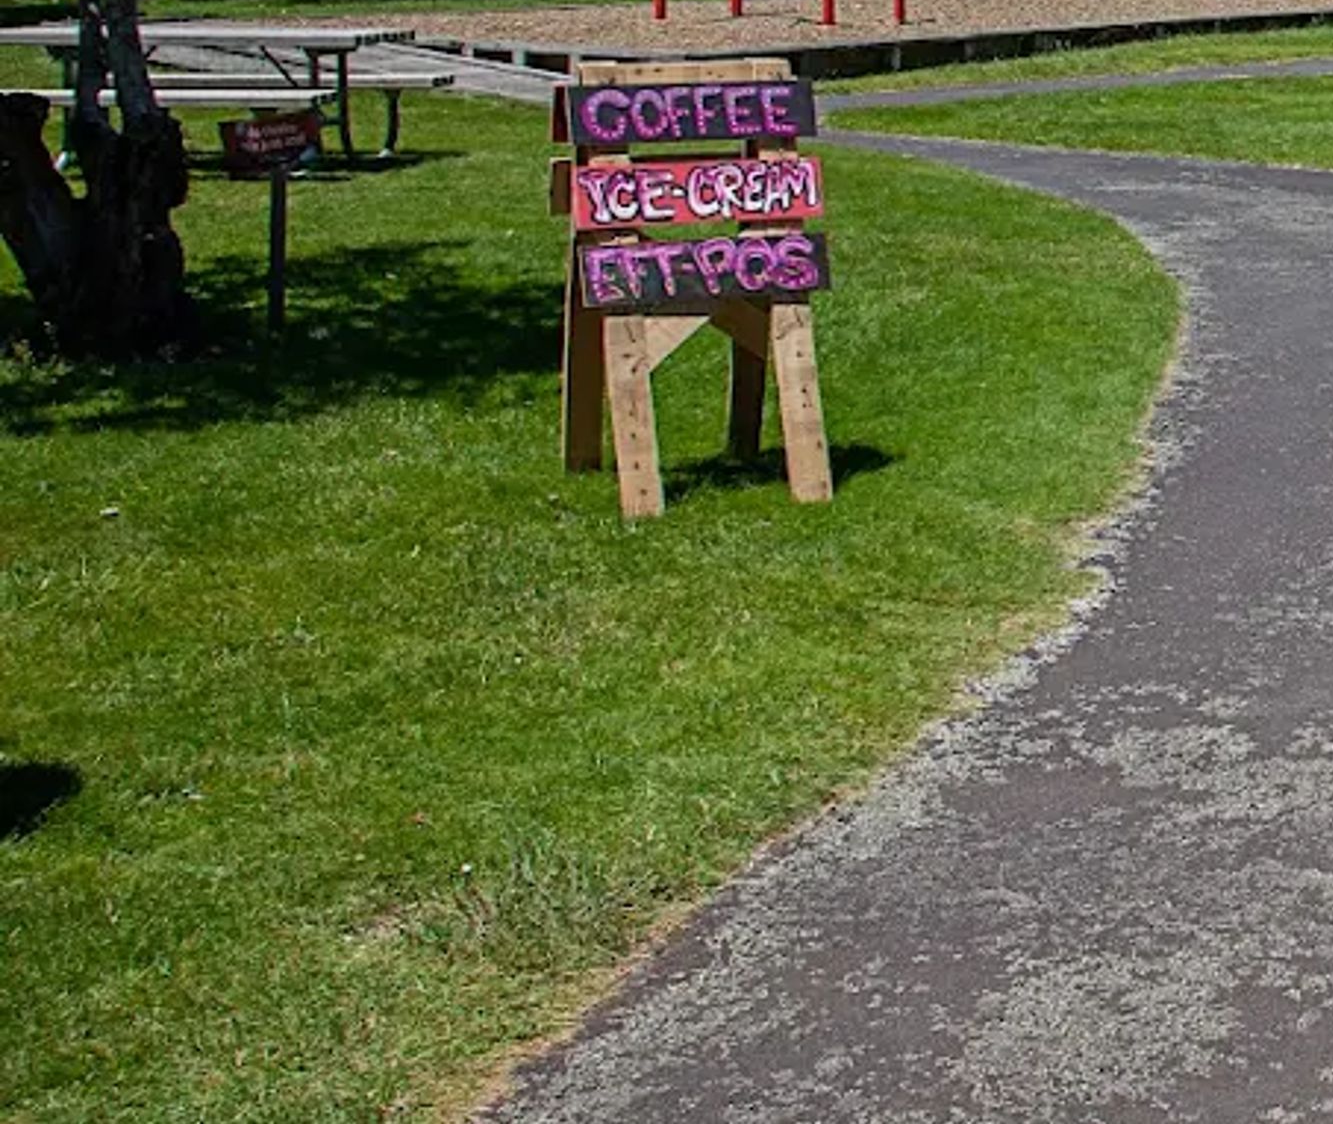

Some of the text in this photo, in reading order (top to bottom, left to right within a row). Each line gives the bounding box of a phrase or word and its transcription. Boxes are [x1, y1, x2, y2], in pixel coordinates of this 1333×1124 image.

[580, 84, 800, 141] COFFEE
[579, 159, 820, 225] ICE-CREAM
[585, 234, 819, 303] EFT-POS
